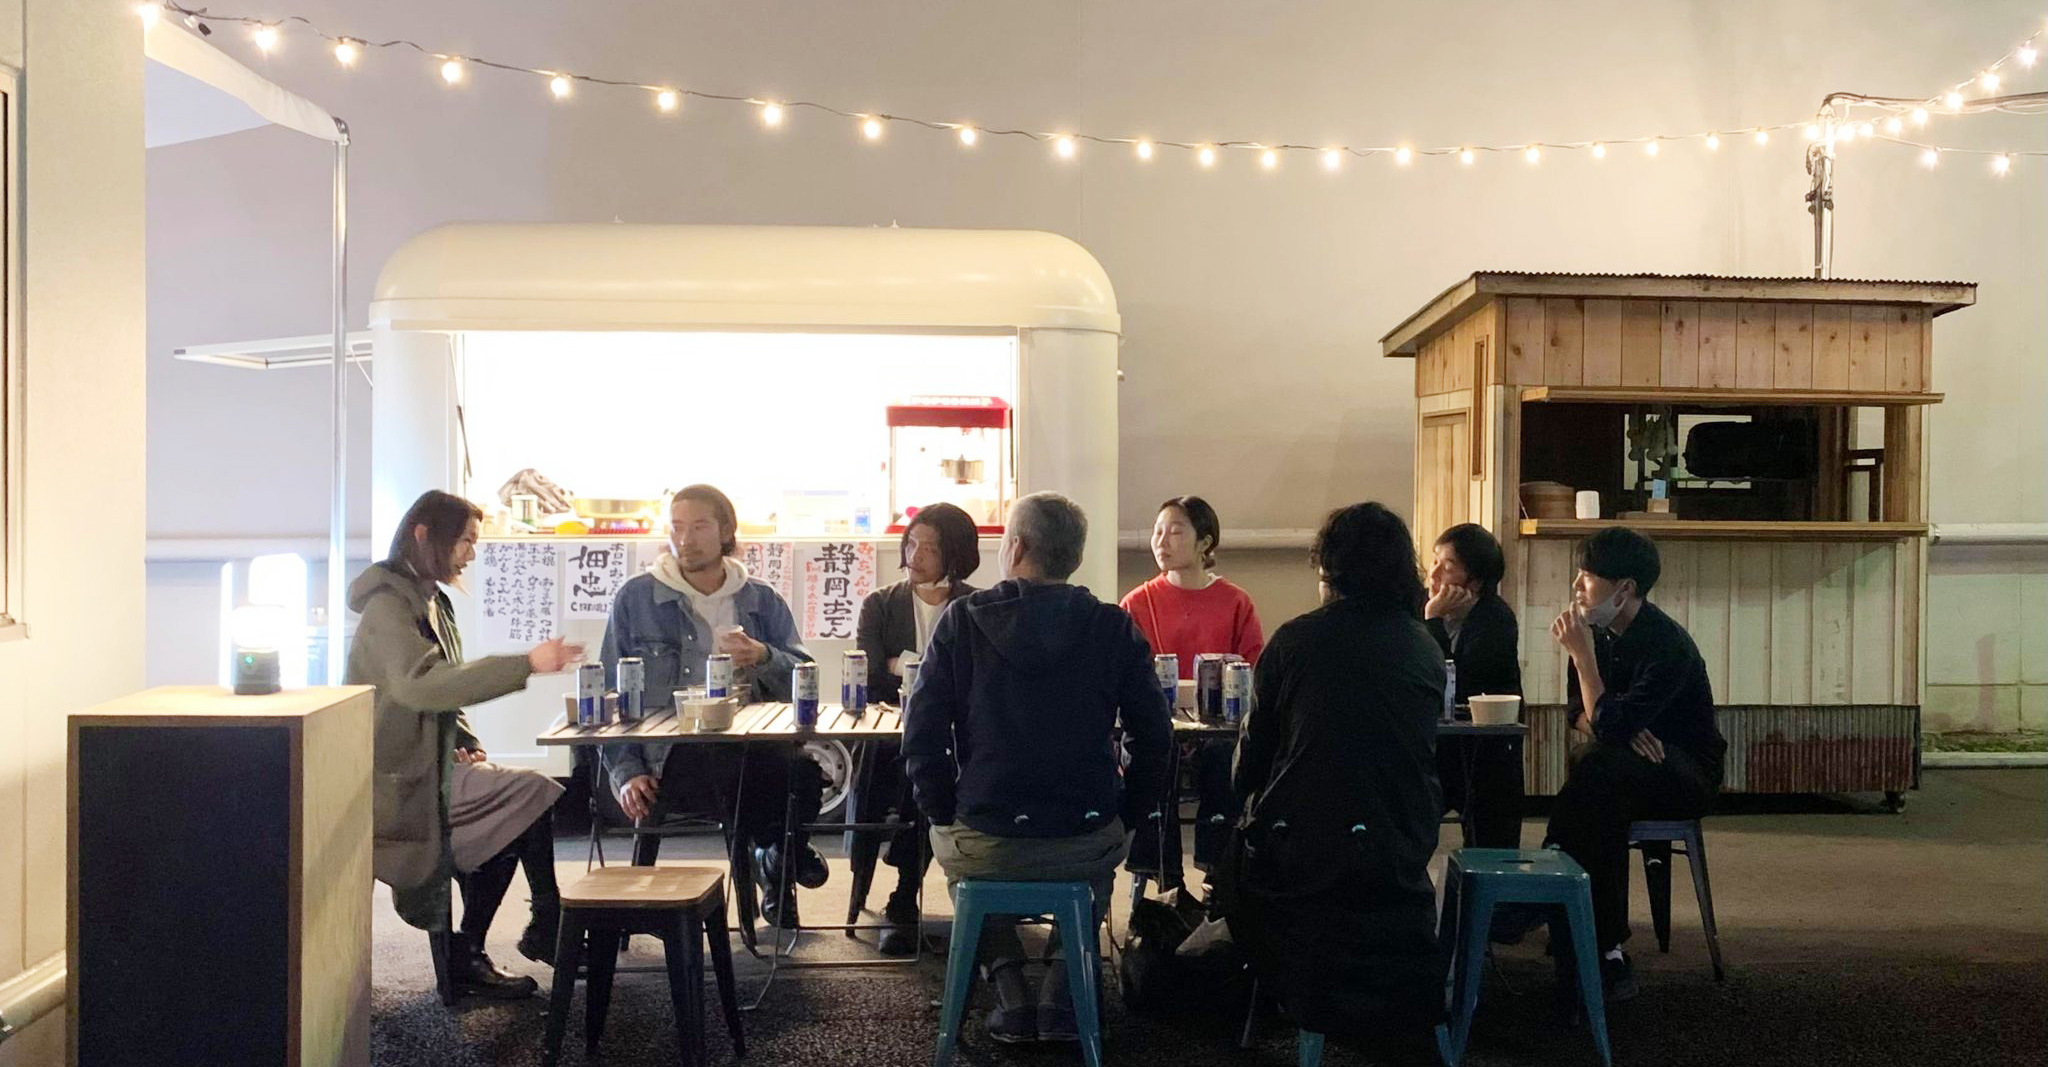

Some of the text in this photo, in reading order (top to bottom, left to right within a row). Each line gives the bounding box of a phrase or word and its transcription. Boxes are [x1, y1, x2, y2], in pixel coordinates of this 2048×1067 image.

[767, 543, 785, 587] 静岡お
[813, 543, 860, 639] 静岡おでん
